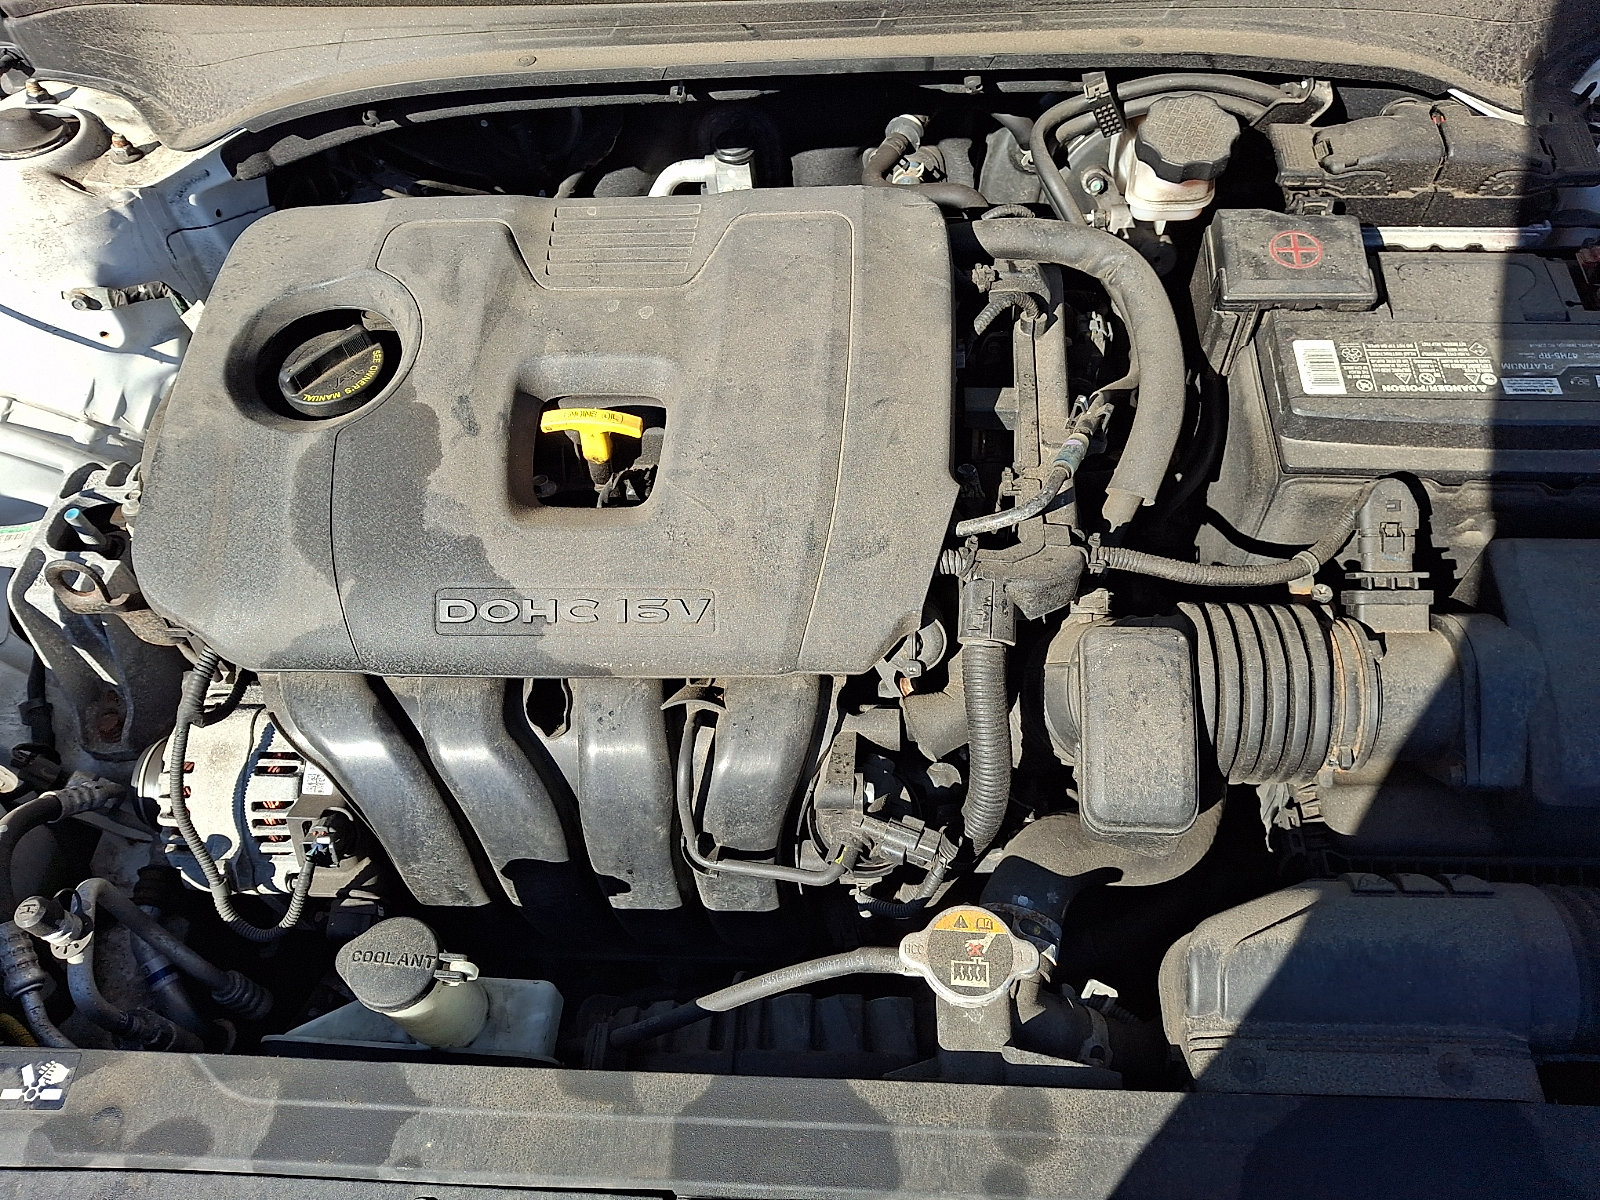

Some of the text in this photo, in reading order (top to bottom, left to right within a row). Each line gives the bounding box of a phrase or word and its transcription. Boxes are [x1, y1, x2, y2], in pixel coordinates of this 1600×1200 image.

[302, 349, 381, 402] SEE OWNER'S MANUAL
[1501, 362, 1554, 370] PLATINUM
[438, 598, 712, 624] DOHC 16V
[352, 950, 436, 969] COOLANT
